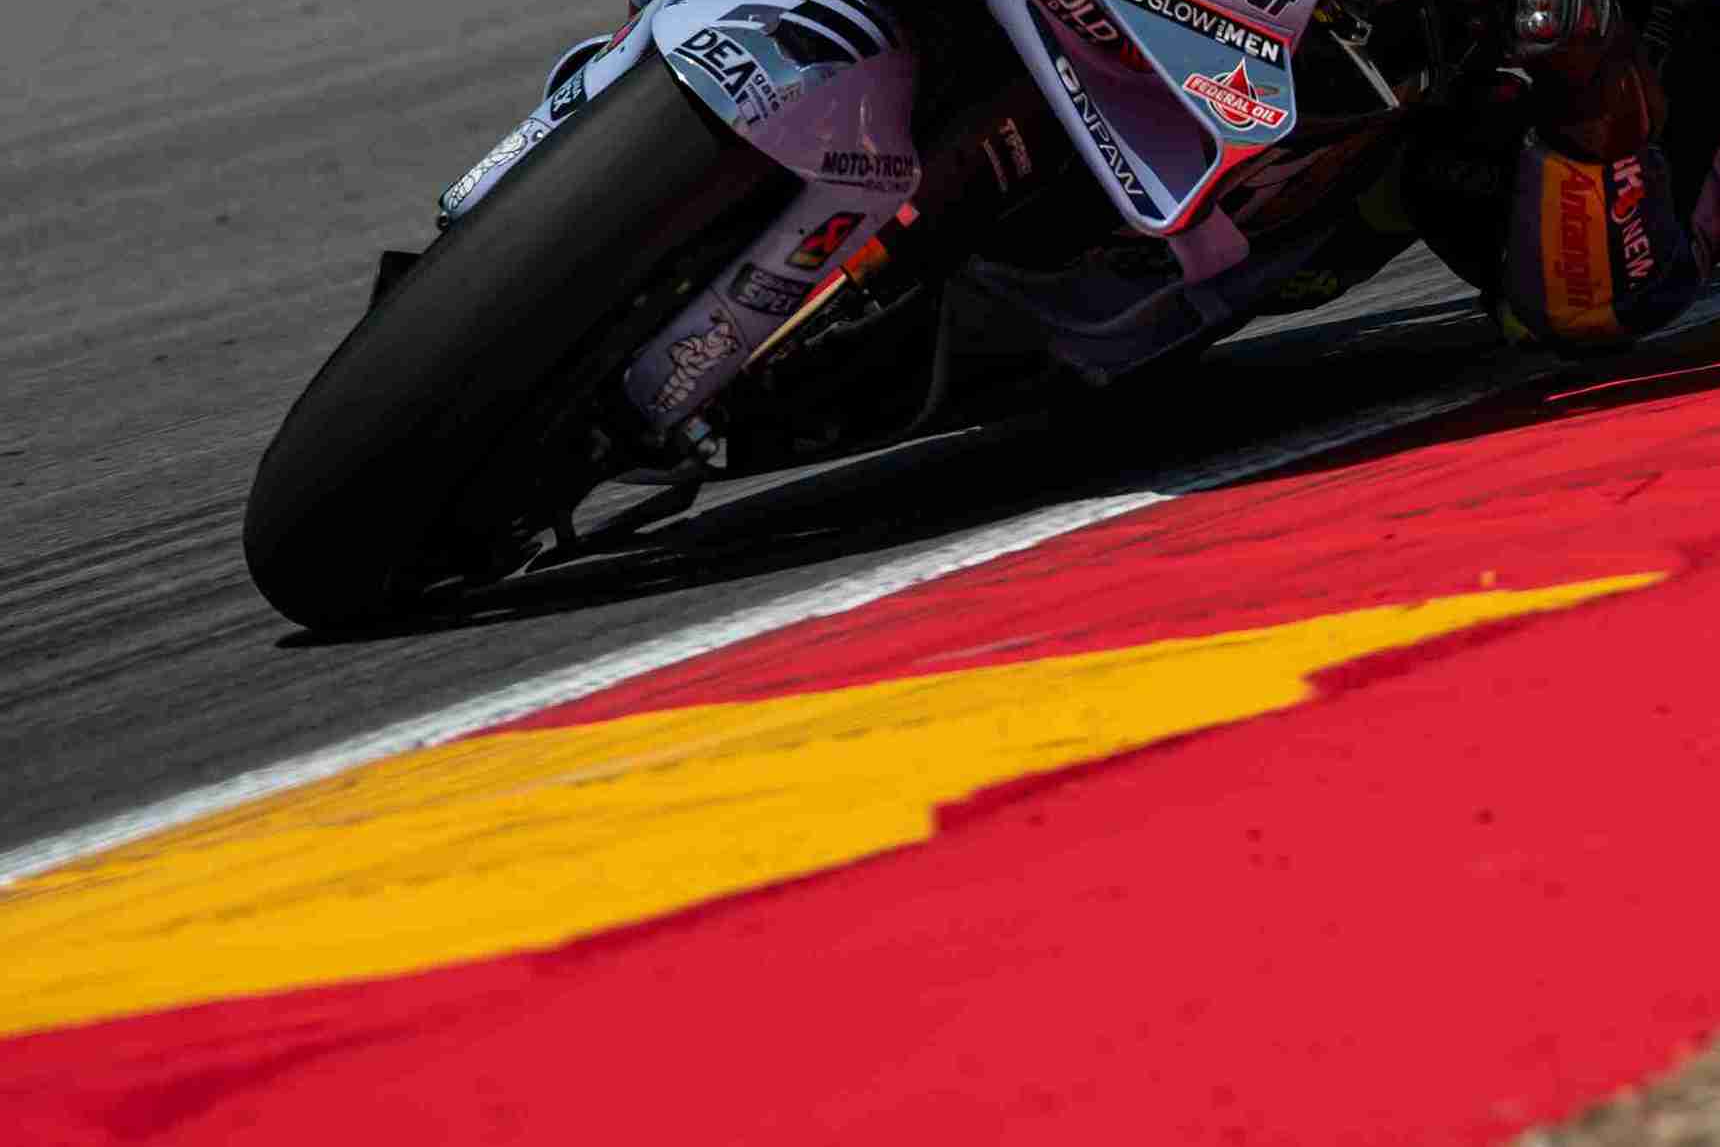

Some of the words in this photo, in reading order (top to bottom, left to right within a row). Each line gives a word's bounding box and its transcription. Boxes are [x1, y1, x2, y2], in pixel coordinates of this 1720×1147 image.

[1225, 27, 1280, 63] MEN
[1189, 77, 1252, 115] FEDERAL
[1251, 103, 1278, 124] OIL
